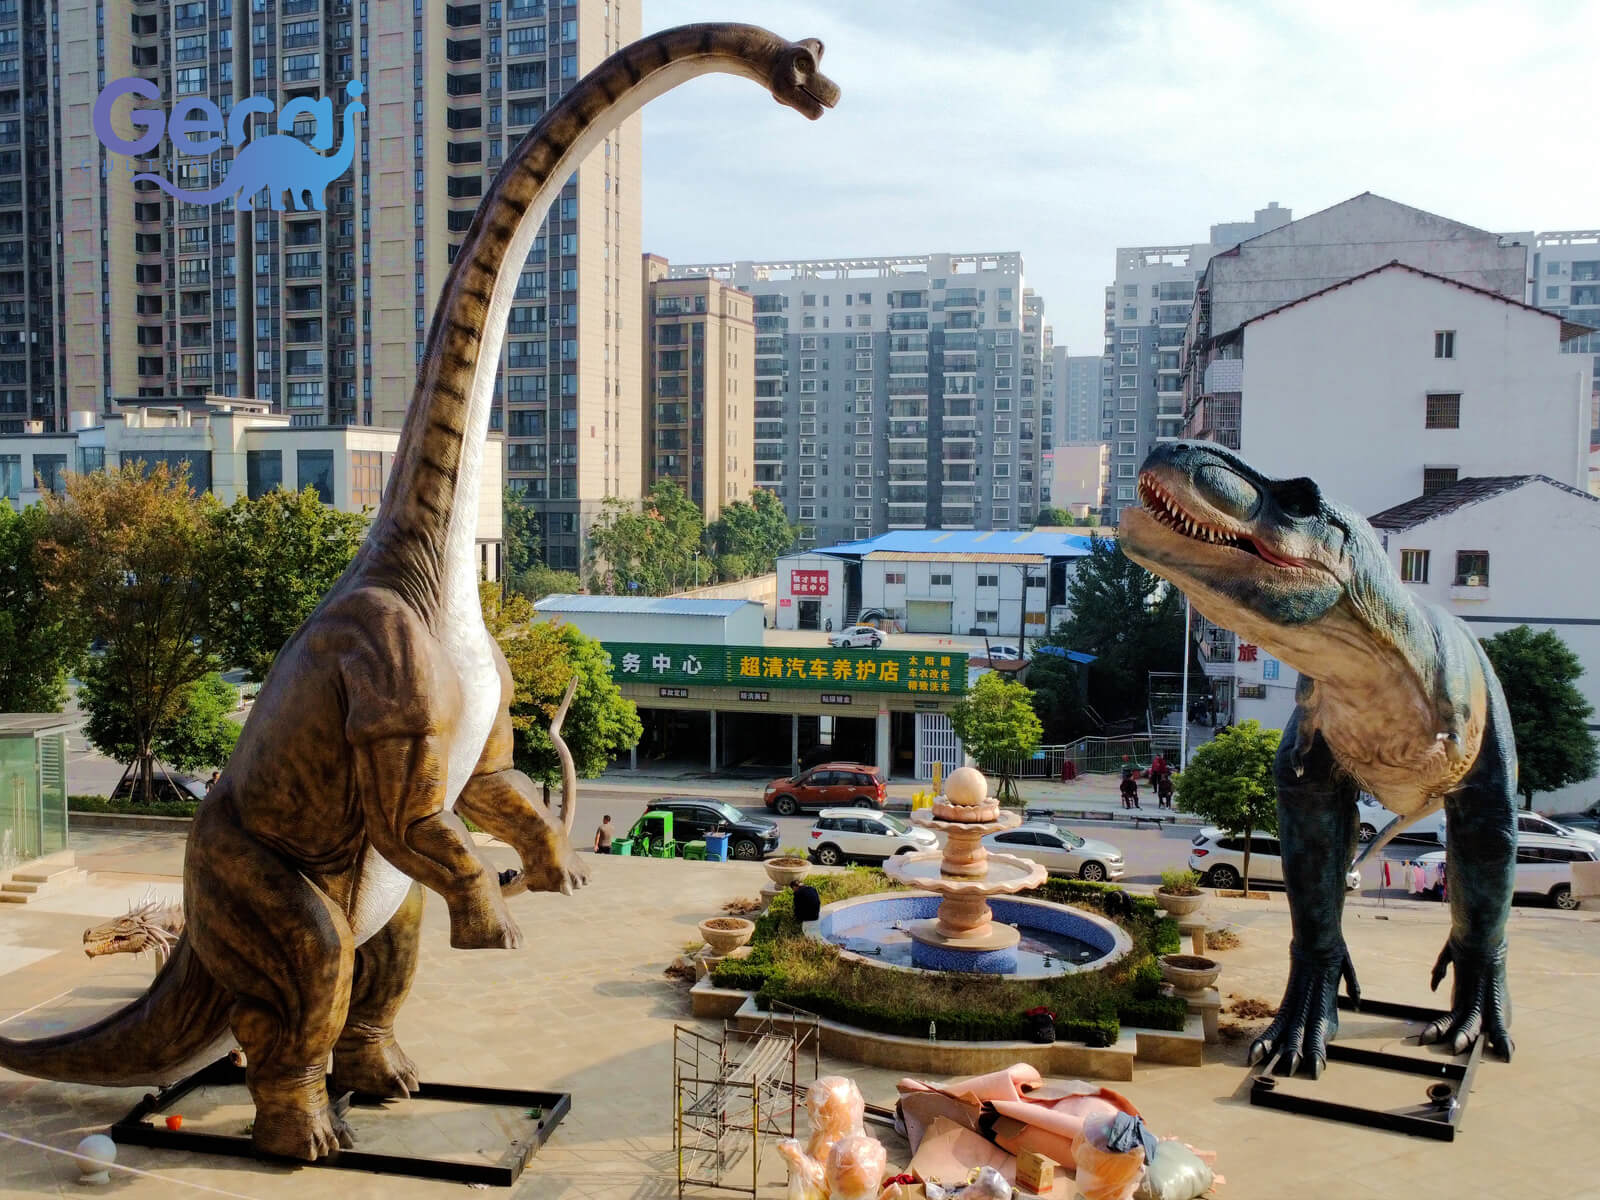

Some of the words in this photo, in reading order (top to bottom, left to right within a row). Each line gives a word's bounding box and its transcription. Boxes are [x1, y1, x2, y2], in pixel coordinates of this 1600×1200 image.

[908, 656, 951, 667] 太阳膜
[740, 656, 899, 681] 超清汽车养护店
[908, 668, 950, 680] 车衣改色
[908, 681, 950, 692] 精致洗车
